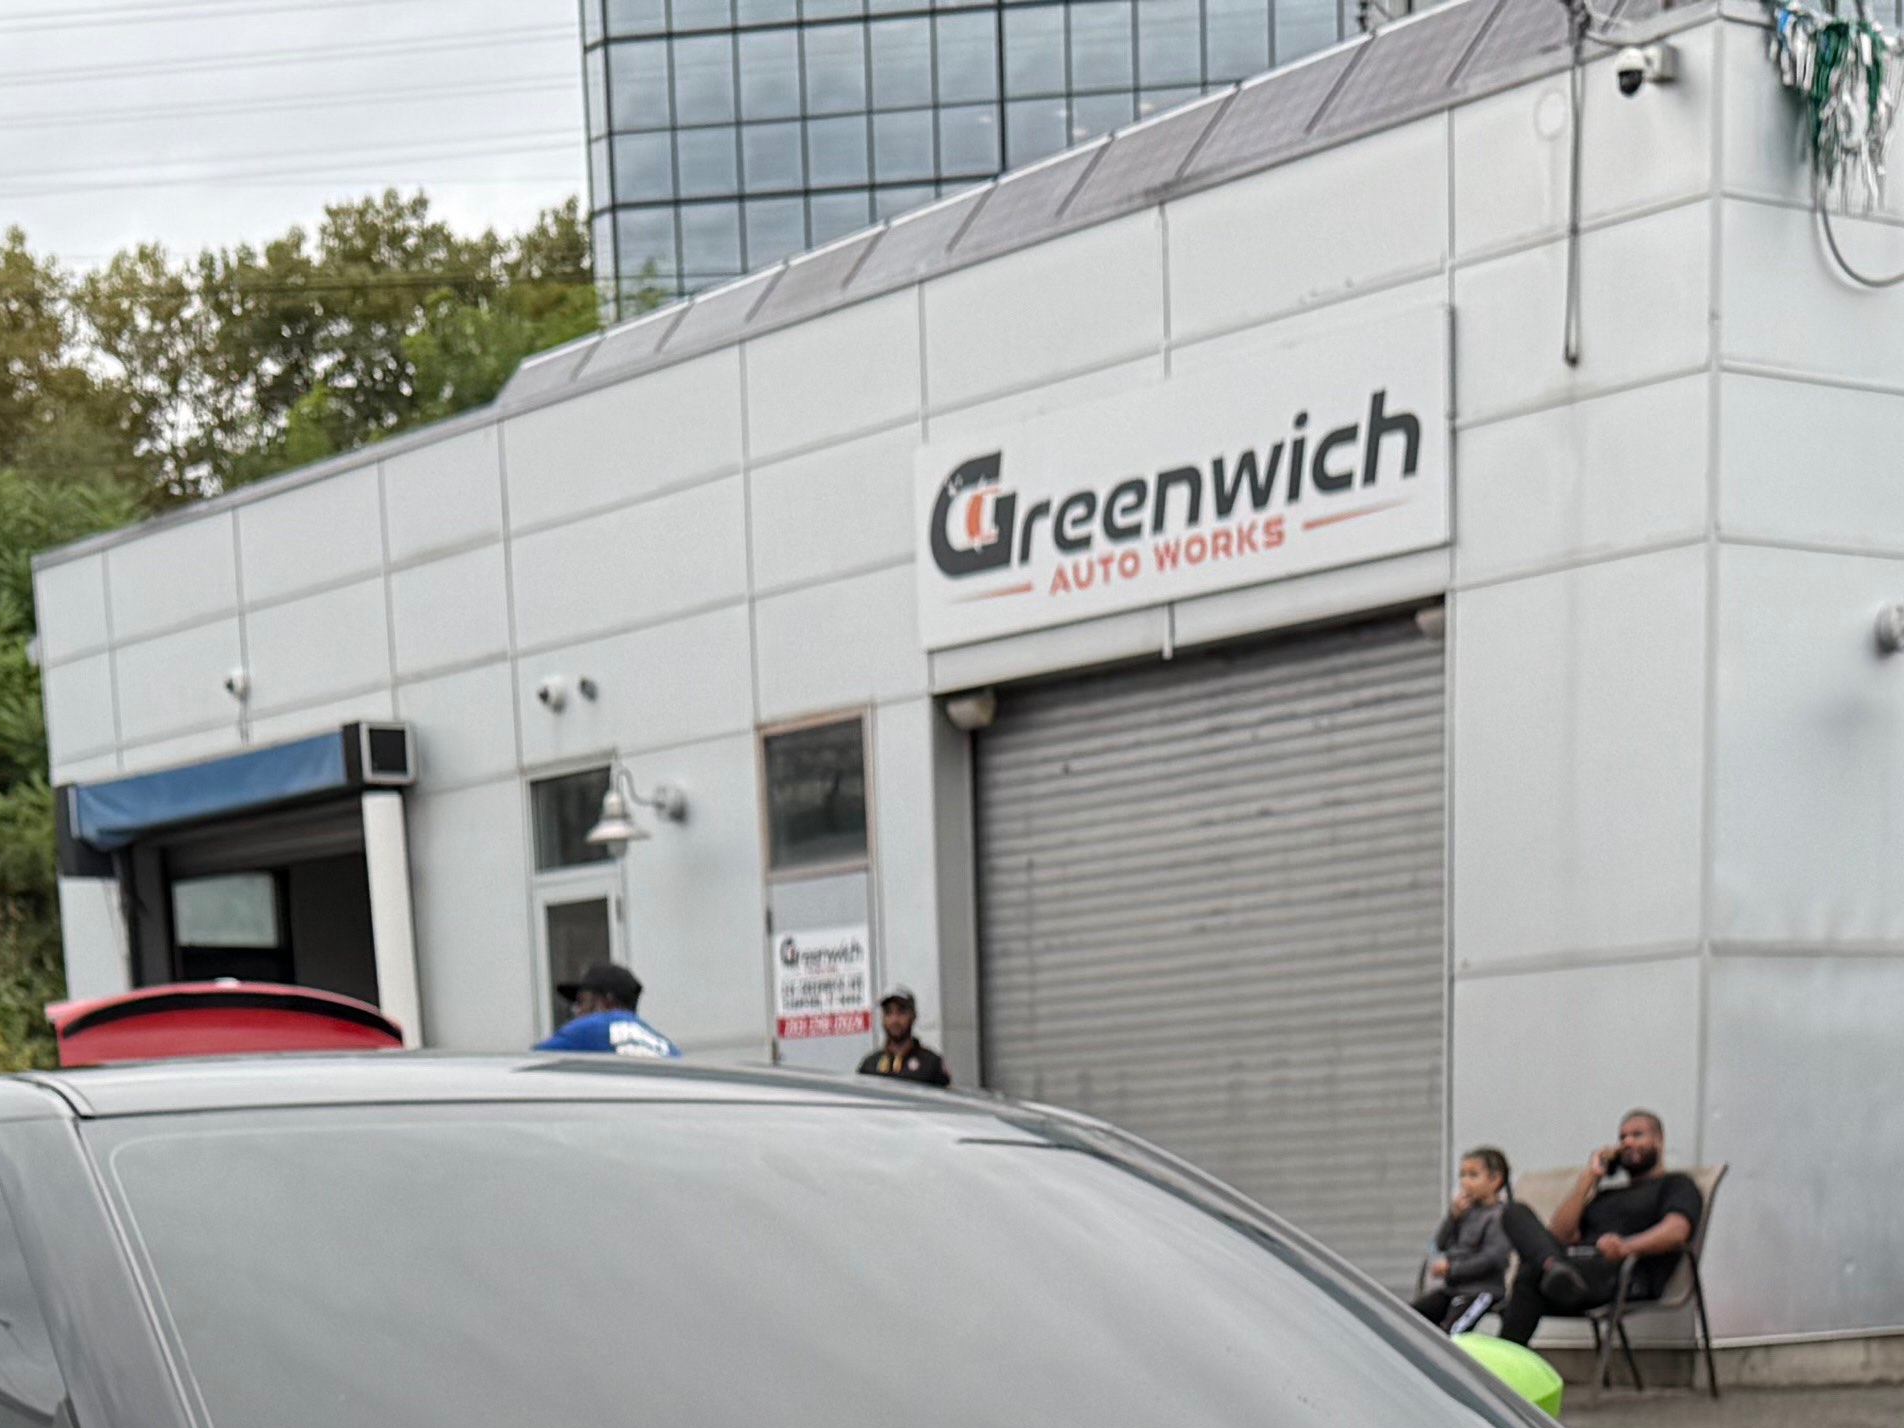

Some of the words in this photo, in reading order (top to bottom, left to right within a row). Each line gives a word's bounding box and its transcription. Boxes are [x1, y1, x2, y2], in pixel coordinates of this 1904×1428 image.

[930, 388, 1421, 579] Greenwich
[1049, 547, 1140, 596] AUTO
[1154, 516, 1286, 573] WORKS
